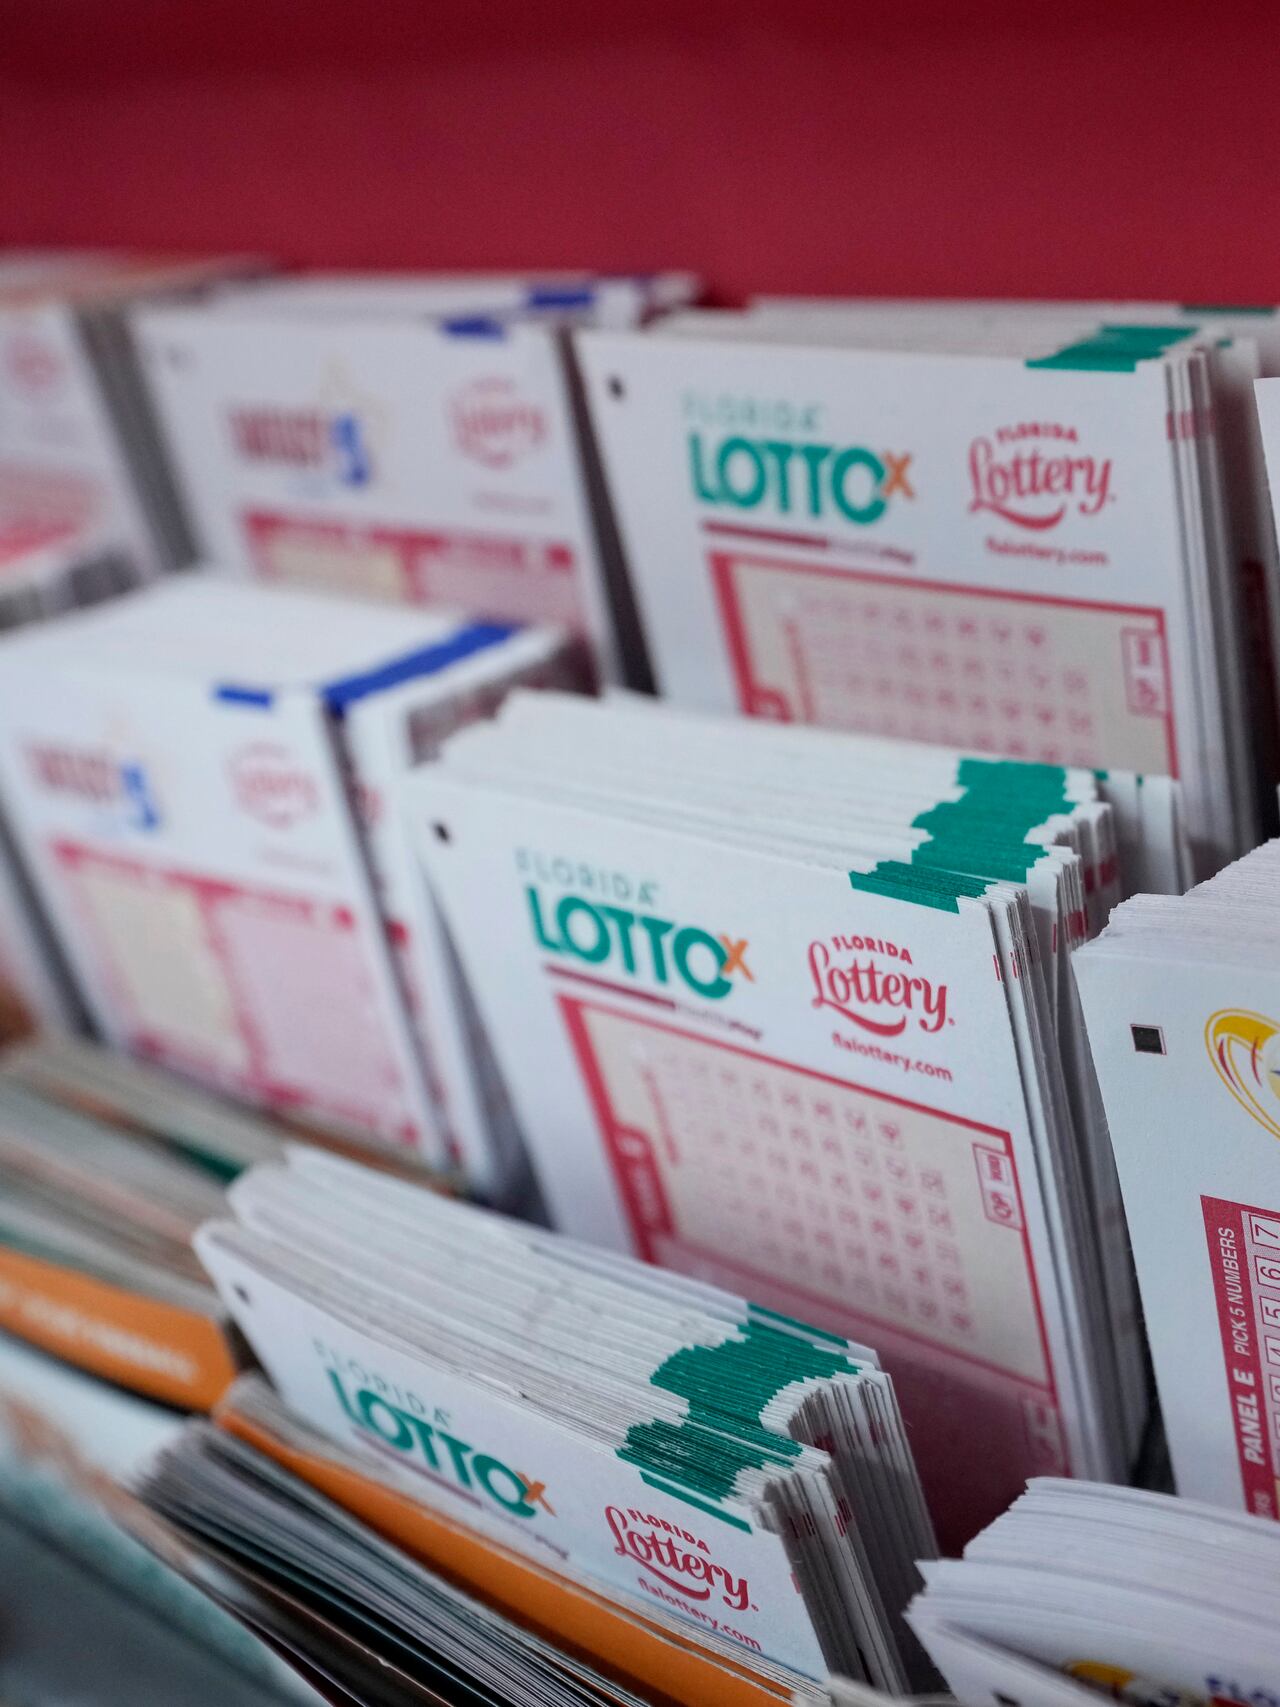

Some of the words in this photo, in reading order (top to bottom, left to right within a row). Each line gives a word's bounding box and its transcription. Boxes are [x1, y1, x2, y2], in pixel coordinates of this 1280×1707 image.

[688, 432, 887, 526] LOTTO
[968, 435, 1112, 532] Lottery
[527, 885, 732, 999] LOTTO
[831, 935, 913, 965] FLORIDA
[807, 939, 948, 1036] Lottery
[832, 1032, 952, 1082] flalottery.com
[1218, 1227, 1241, 1301] NUMBERS
[1256, 1224, 1279, 1239] 7
[1230, 1307, 1243, 1317] 5
[1231, 1320, 1249, 1355] PICK
[1233, 1372, 1255, 1386] E
[1237, 1394, 1265, 1465] PANEL
[605, 1505, 749, 1611] Lottery
[627, 1508, 711, 1555] FLORIDA
[638, 1577, 762, 1652] flalottery.com
